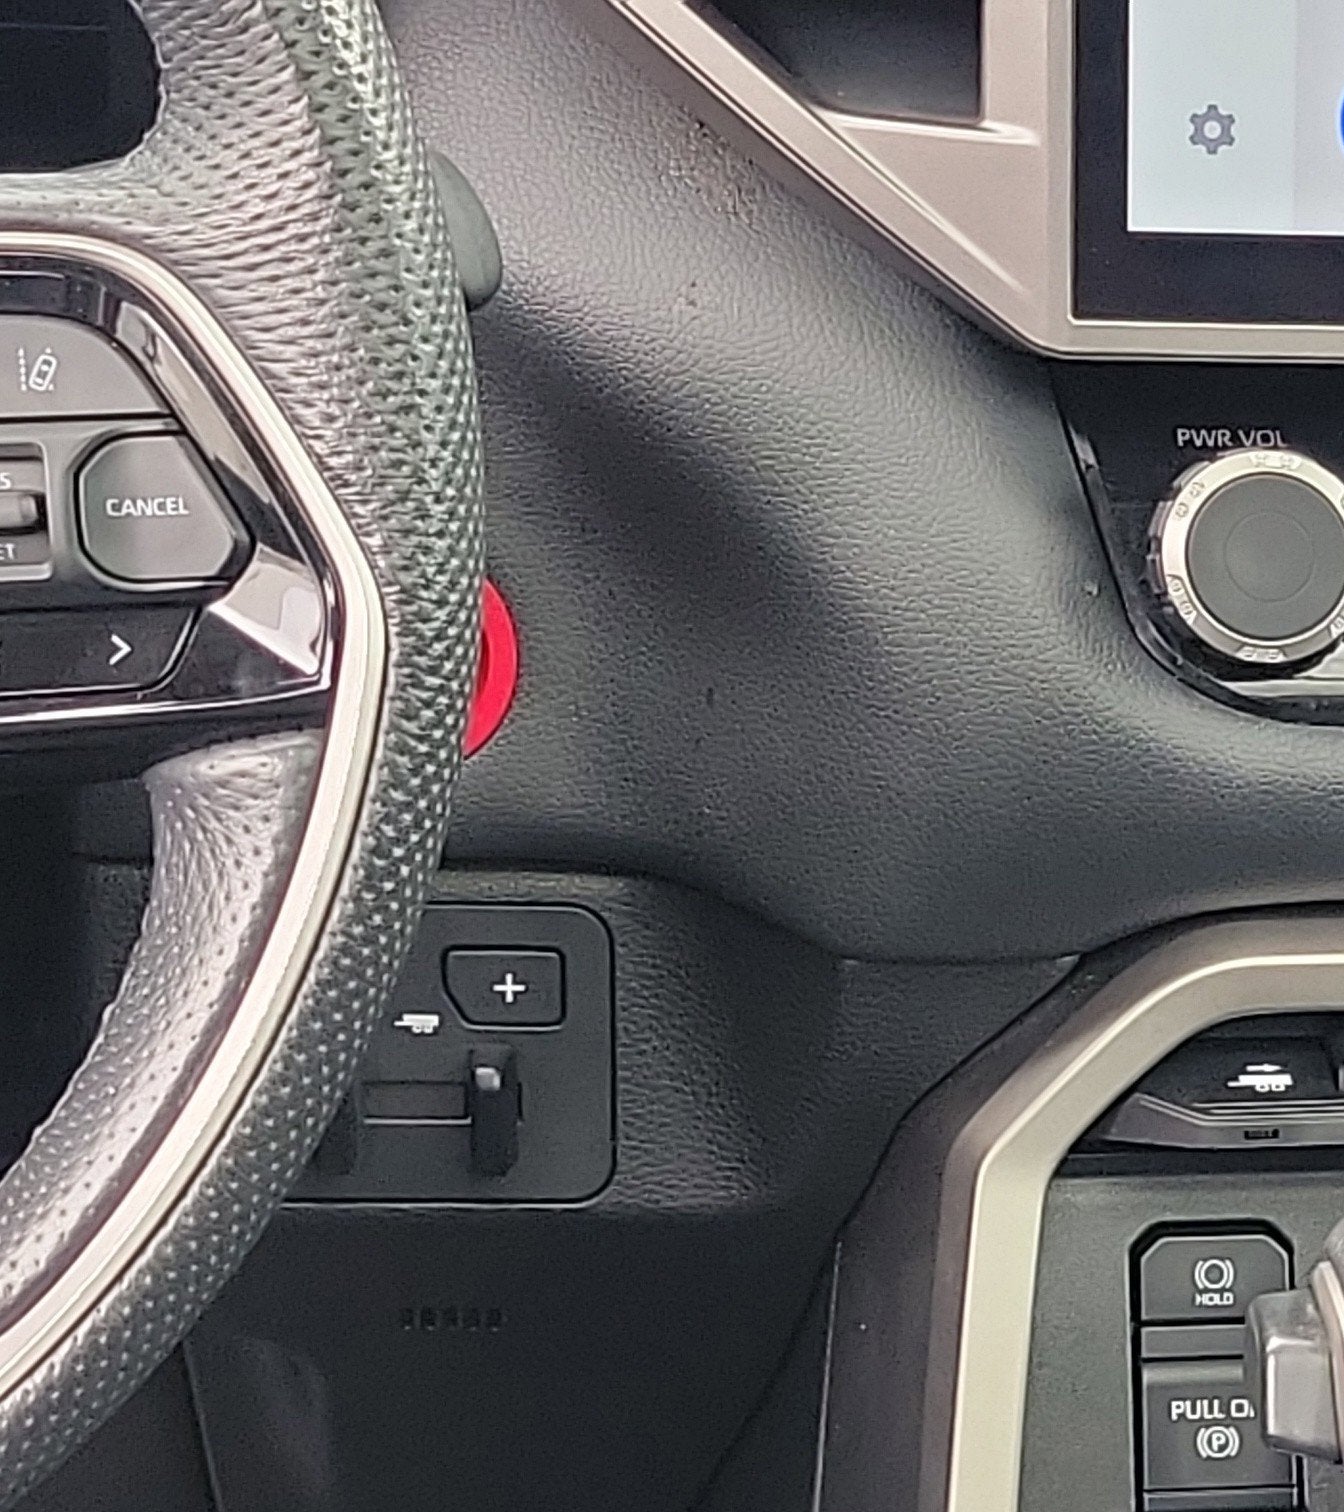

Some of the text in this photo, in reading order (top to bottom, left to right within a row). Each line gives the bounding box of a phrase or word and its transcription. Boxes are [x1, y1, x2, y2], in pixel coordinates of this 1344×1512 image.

[1176, 428, 1289, 448] PWR VOL
[105, 497, 190, 519] CANCEL
[1195, 1292, 1234, 1306] HOLD
[1170, 1398, 1226, 1422] PULL
